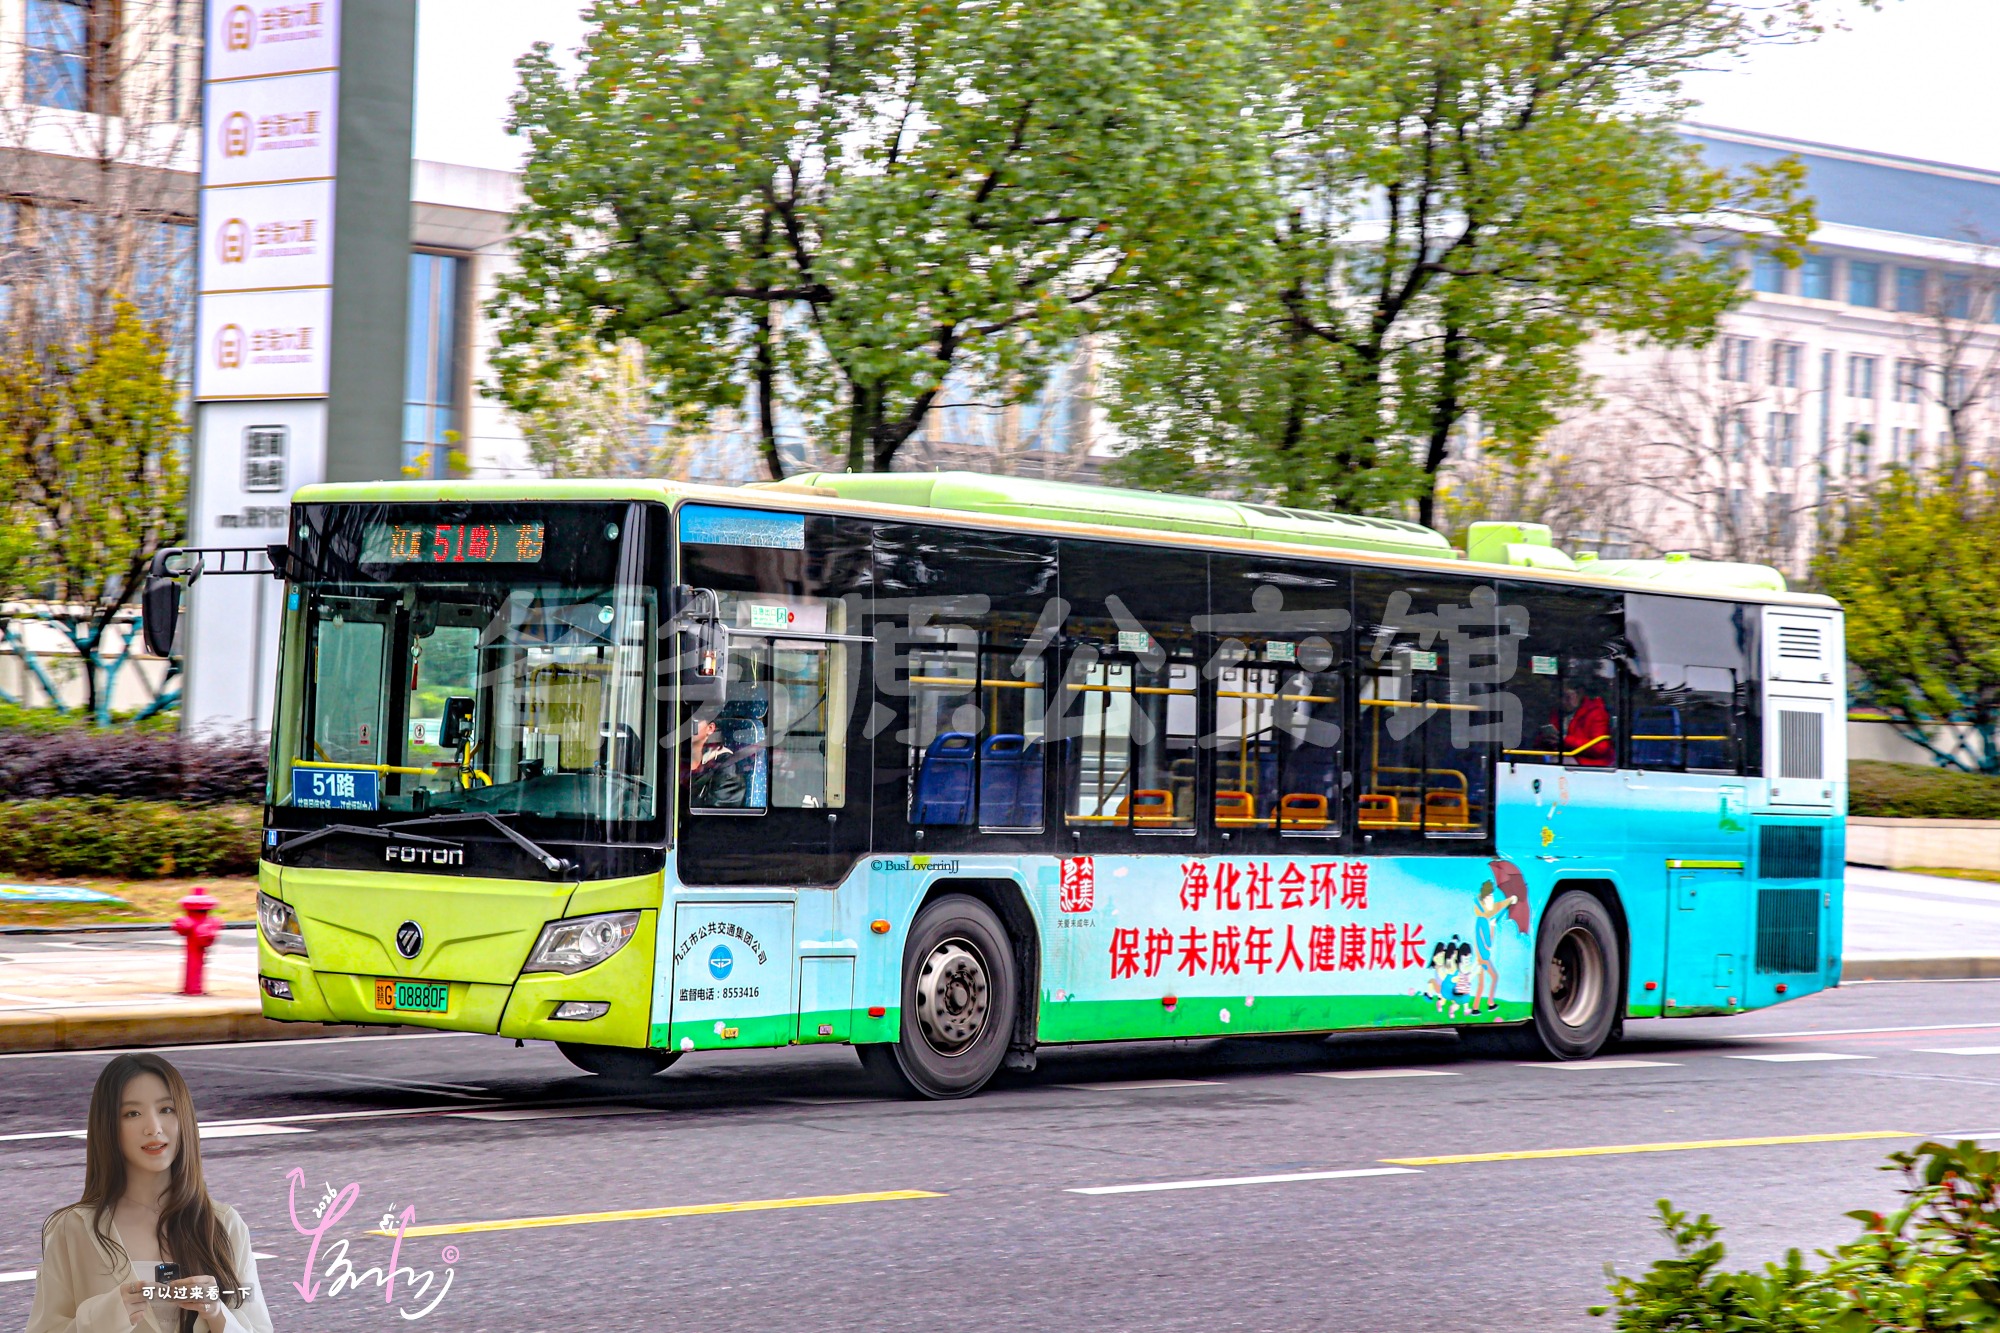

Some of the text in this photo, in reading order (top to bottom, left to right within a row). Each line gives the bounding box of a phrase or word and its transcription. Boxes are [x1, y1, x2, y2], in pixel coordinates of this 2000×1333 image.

[313, 773, 355, 798] 51路
[385, 846, 463, 865] FOTON
[1179, 861, 1369, 912] 净化社会环境
[674, 922, 768, 965] 九江市公共交通集团公司
[1109, 922, 1427, 980] 保护未成年人健康成长
